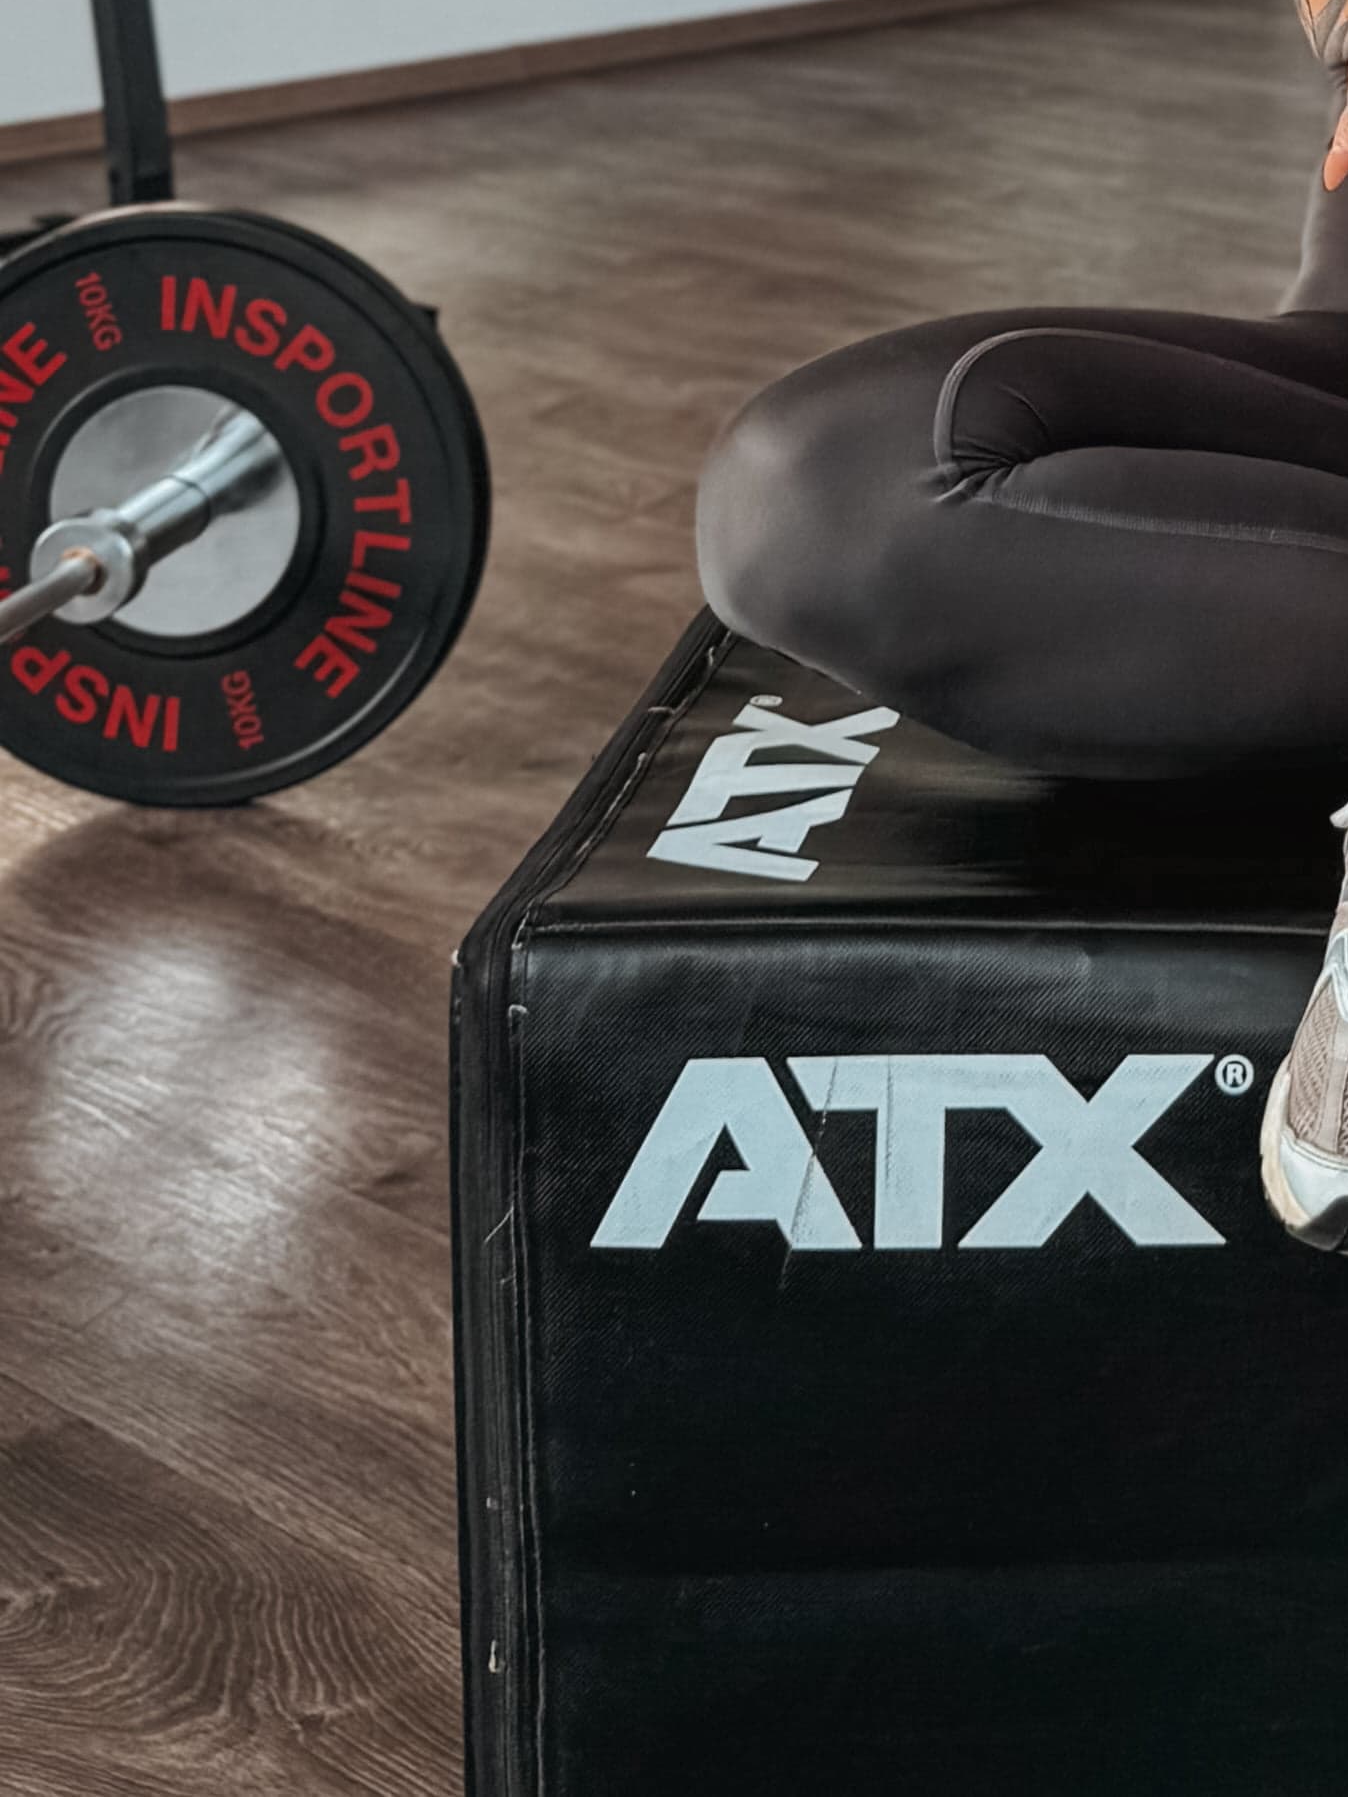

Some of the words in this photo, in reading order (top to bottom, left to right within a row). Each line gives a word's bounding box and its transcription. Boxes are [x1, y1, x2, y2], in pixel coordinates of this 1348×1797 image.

[74, 271, 122, 352] 10KG
[159, 274, 412, 699] INSPORTLINE
[221, 669, 265, 751] 10KG
